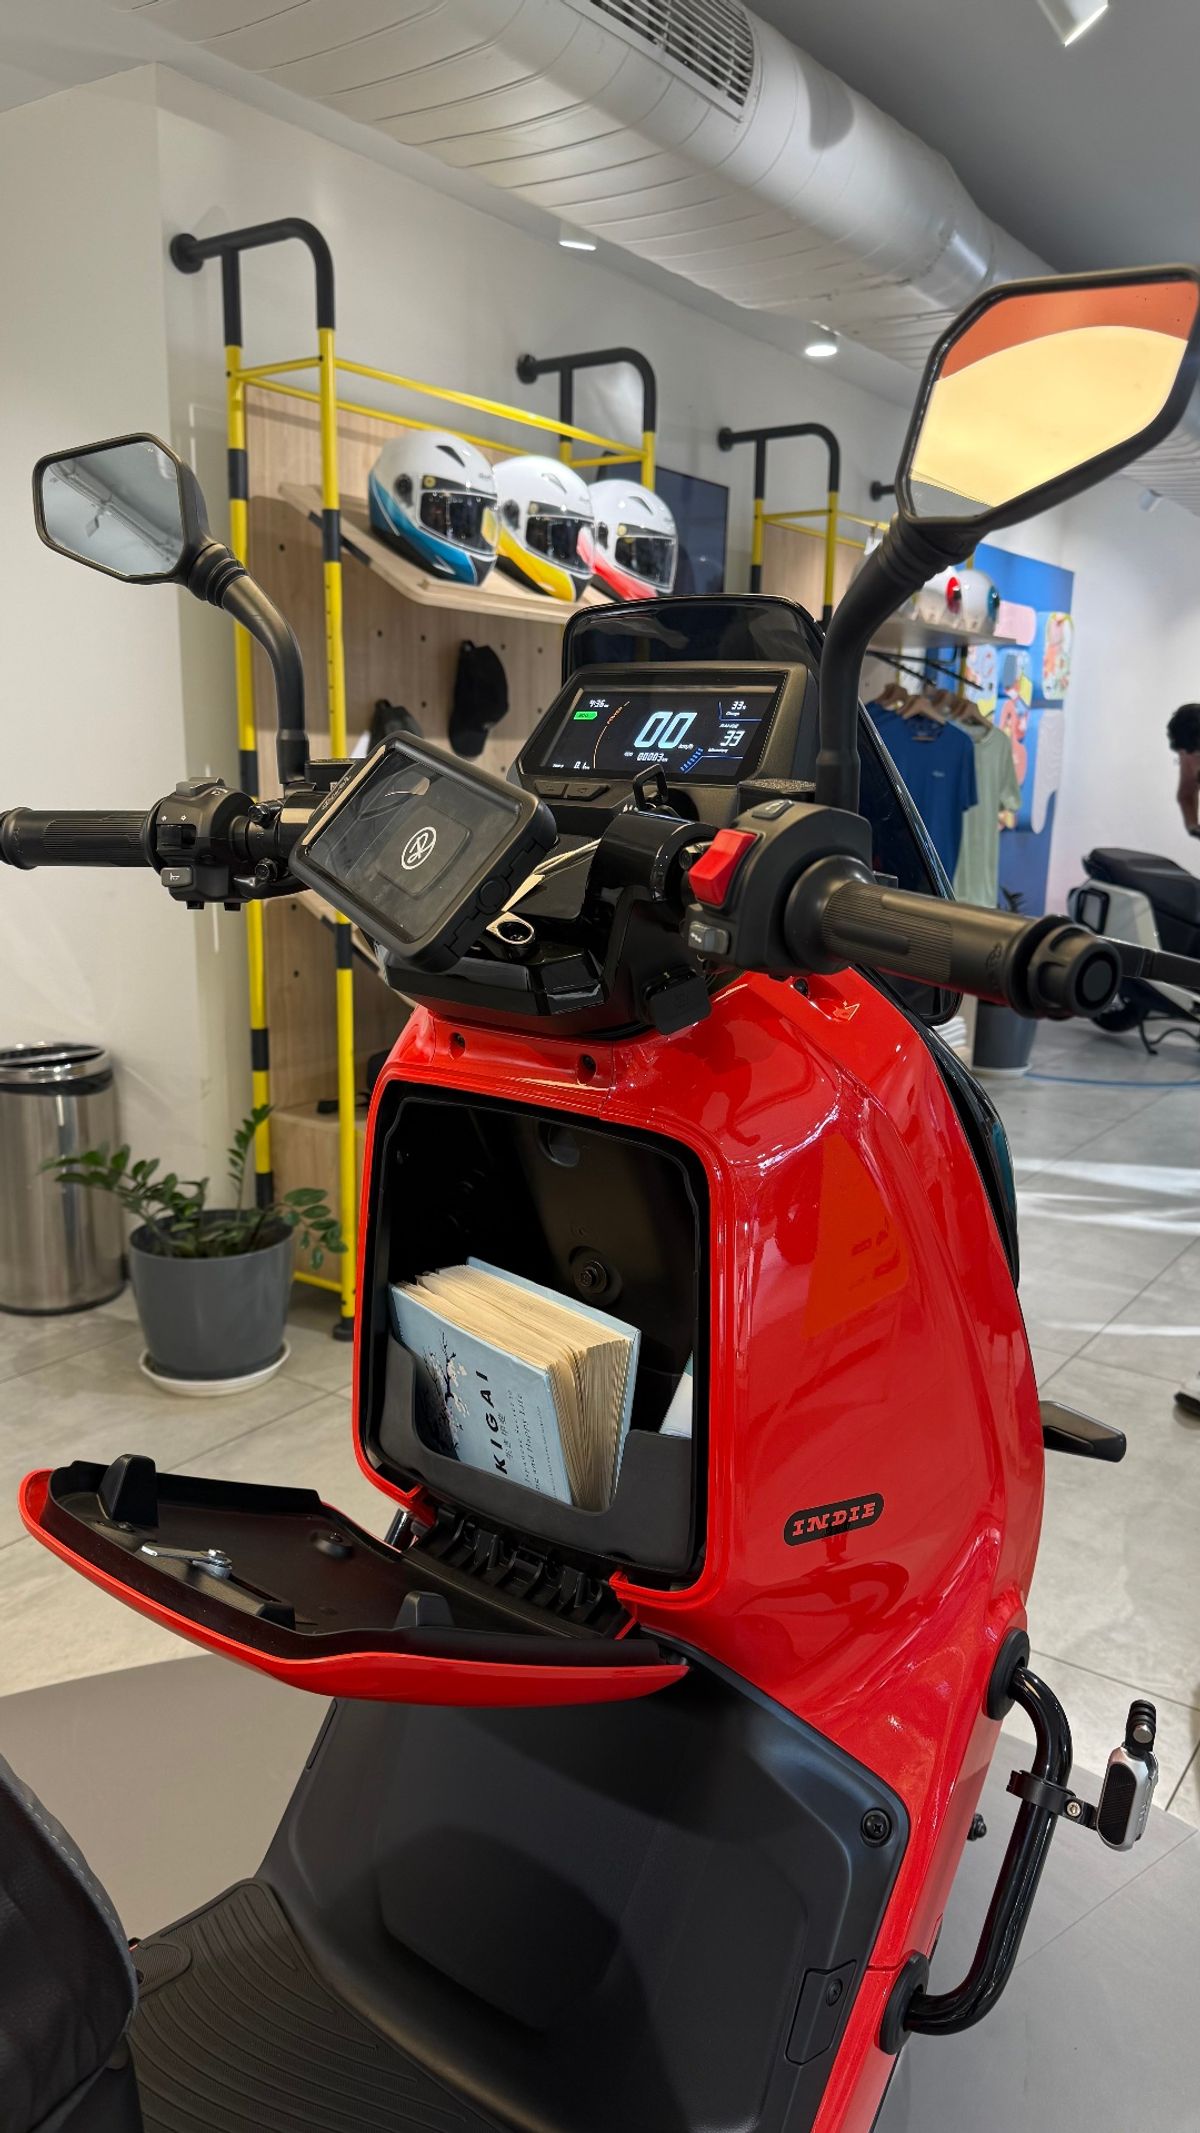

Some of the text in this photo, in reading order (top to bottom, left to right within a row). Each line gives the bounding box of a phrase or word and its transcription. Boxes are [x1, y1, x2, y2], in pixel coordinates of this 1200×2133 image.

[633, 711, 698, 749] 00
[720, 730, 745, 747] 33
[792, 1502, 876, 1537] INDIE
